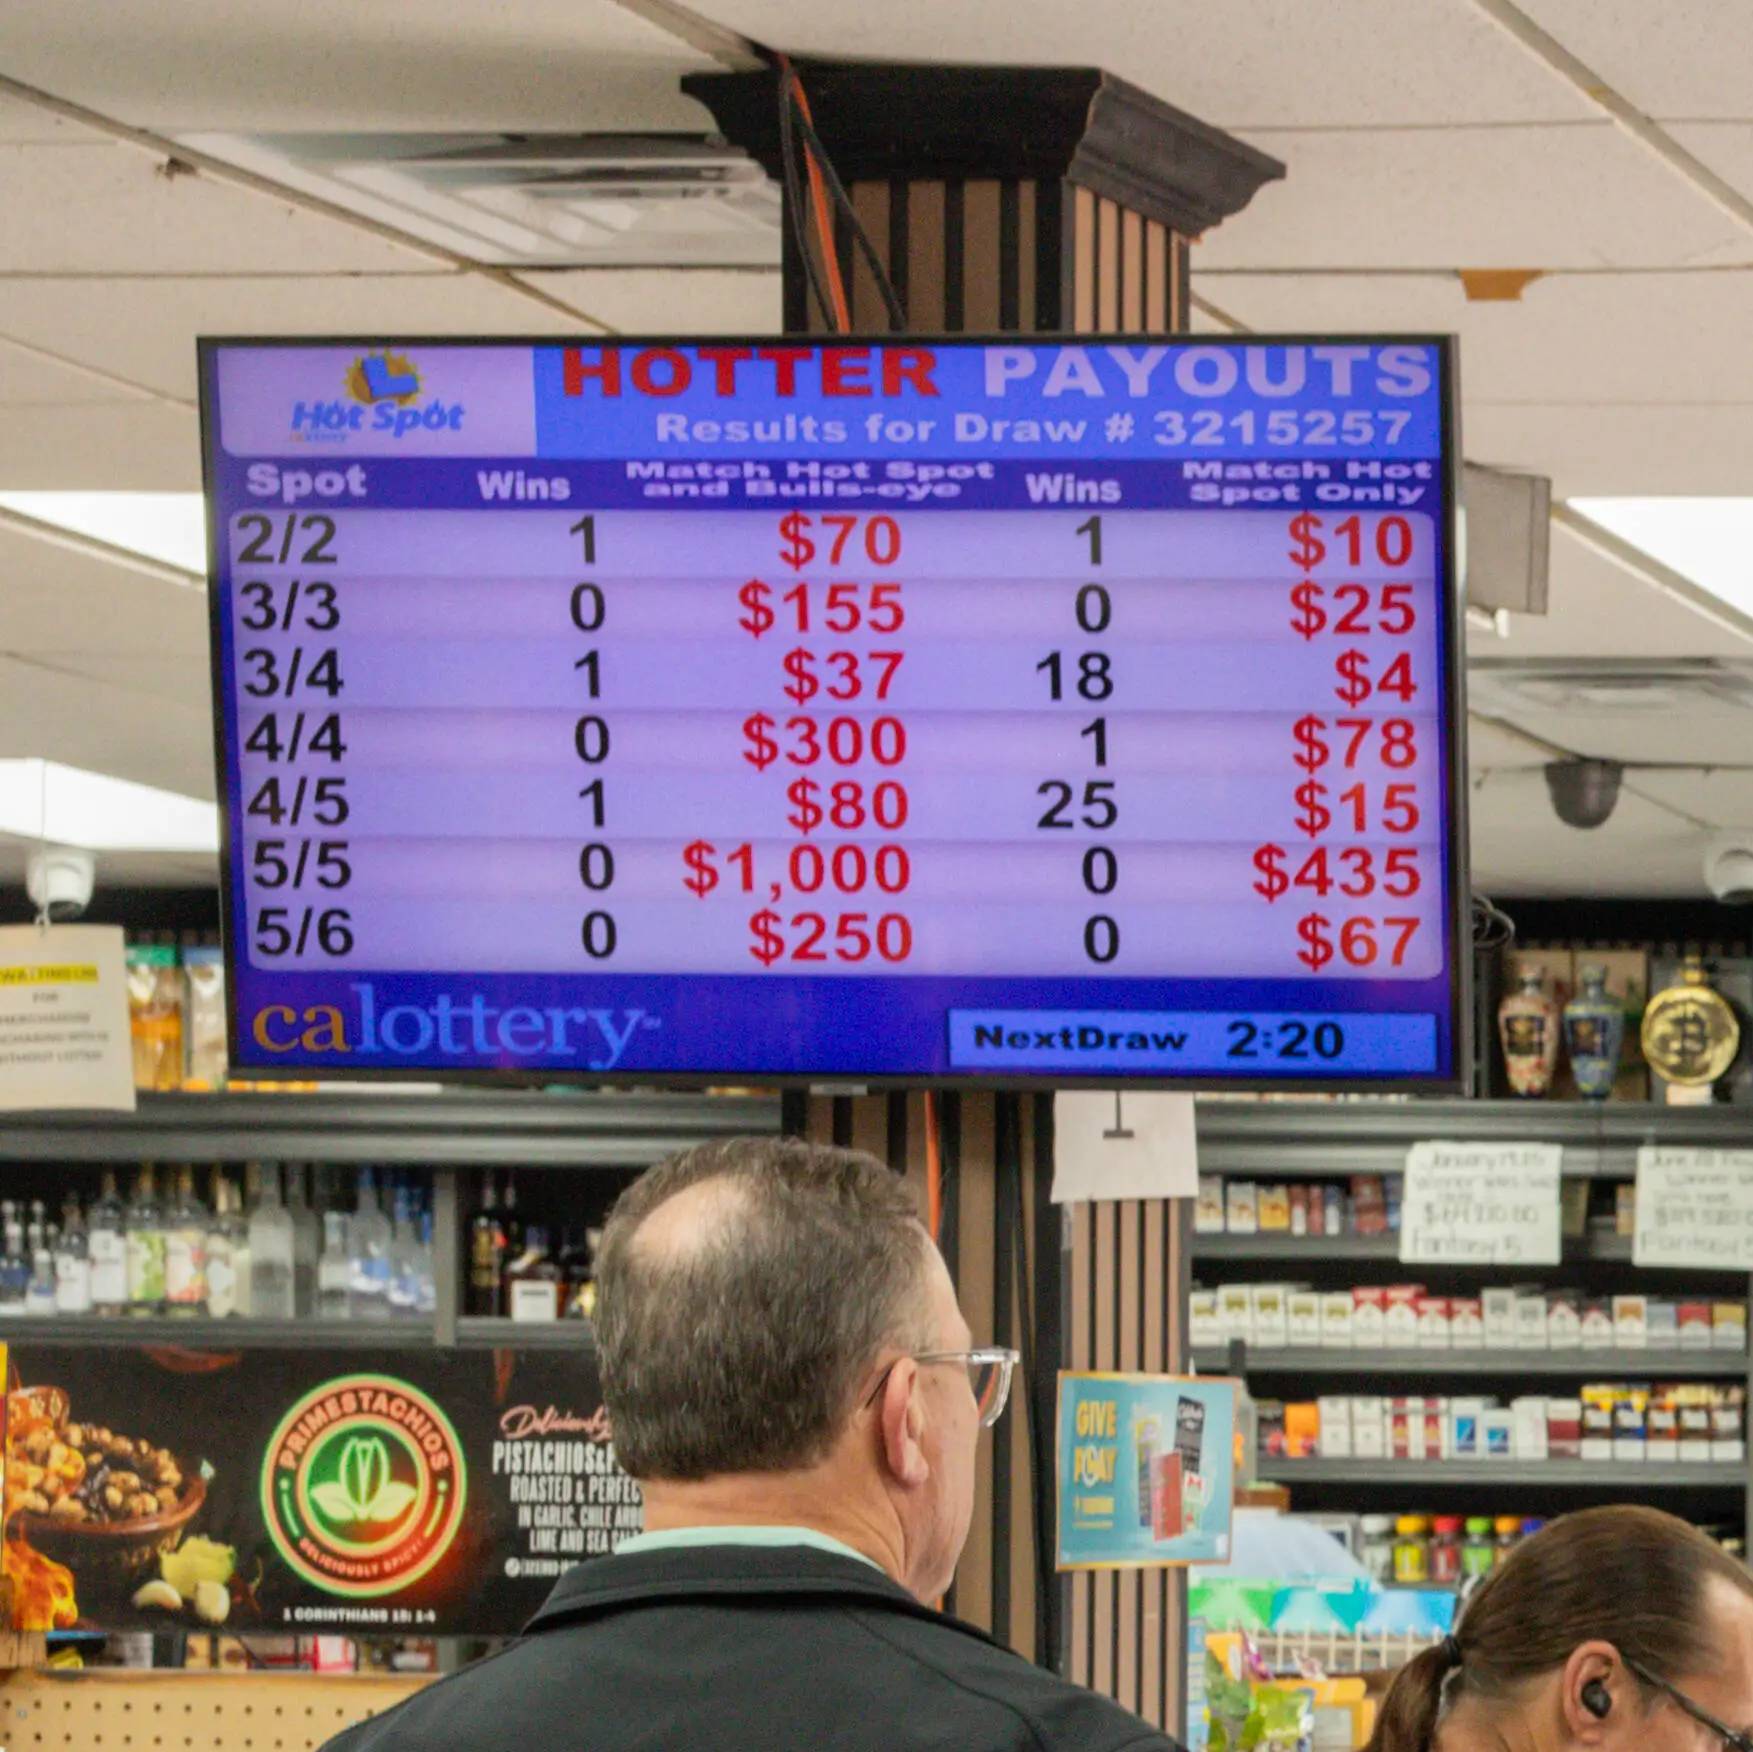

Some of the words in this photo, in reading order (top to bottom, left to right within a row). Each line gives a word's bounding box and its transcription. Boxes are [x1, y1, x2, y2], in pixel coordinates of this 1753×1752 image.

[562, 346, 941, 397] HOTTER
[985, 346, 1432, 400] PAYOUTS
[291, 400, 370, 430] Hot
[371, 399, 465, 438] Spot
[656, 413, 847, 444] Results
[866, 413, 936, 443] for
[955, 413, 1087, 444] Draw
[1106, 413, 1135, 443] #
[1154, 410, 1412, 446] 3215257
[246, 463, 368, 501] Spot
[477, 470, 571, 501] Wins
[626, 461, 771, 480] Match
[785, 461, 869, 480] Hot
[884, 461, 995, 482] Spot
[643, 480, 729, 498] and
[745, 480, 962, 499] Bulls-eye
[1025, 473, 1122, 504] Wins
[1182, 461, 1320, 480] Match
[1352, 461, 1433, 480] Hot
[1188, 483, 1303, 505] Spot
[1314, 483, 1425, 505] Only
[237, 514, 338, 565] 2/2
[570, 515, 596, 565] 1
[778, 509, 902, 571] $70
[1076, 516, 1102, 565] 1
[1288, 509, 1412, 571] $10
[239, 581, 340, 632] 3/3
[570, 582, 606, 633] 0
[737, 578, 905, 639] $155
[1075, 584, 1112, 634] 0
[1290, 579, 1416, 641] $25
[243, 648, 345, 699] 3/4
[575, 650, 600, 699] 1
[782, 647, 905, 705] $37
[1036, 652, 1114, 701] 18
[1335, 648, 1417, 708] $4
[245, 713, 347, 764] 4/4
[575, 715, 610, 764] 0
[742, 712, 907, 772] $300
[1080, 718, 1107, 766] 1
[1293, 713, 1418, 775] $78
[247, 777, 350, 826] 4/5
[579, 780, 605, 828] 1
[786, 777, 909, 835] $80
[1037, 779, 1118, 830] 25
[1294, 779, 1420, 839] $15
[252, 840, 353, 890] 5/5
[580, 843, 615, 891] 0
[682, 839, 910, 901] $1,000
[1082, 847, 1117, 896] 0
[1252, 843, 1421, 904] $435
[255, 907, 355, 957] 5/6
[582, 910, 618, 960] 0
[749, 908, 913, 968] $250
[1084, 915, 1120, 965] 0
[1296, 913, 1421, 973] $67
[252, 984, 643, 1071] calottery
[973, 1025, 1189, 1052] NextDraw
[1227, 1021, 1345, 1059] 2:20
[279, 1389, 451, 1472] PRIMESTACHIOS
[1075, 1400, 1118, 1438] GIVE
[510, 1475, 573, 1504] ROASTED
[575, 1478, 585, 1504] &
[588, 1474, 642, 1504] PERFEC
[518, 1504, 532, 1528] IN
[580, 1504, 613, 1529] CHILE
[299, 1536, 379, 1578] DELICIOUSLY
[529, 1529, 557, 1554] LIME
[560, 1529, 584, 1553] AND
[586, 1529, 609, 1554] SEA
[294, 1607, 388, 1623] CORINTHIANS
